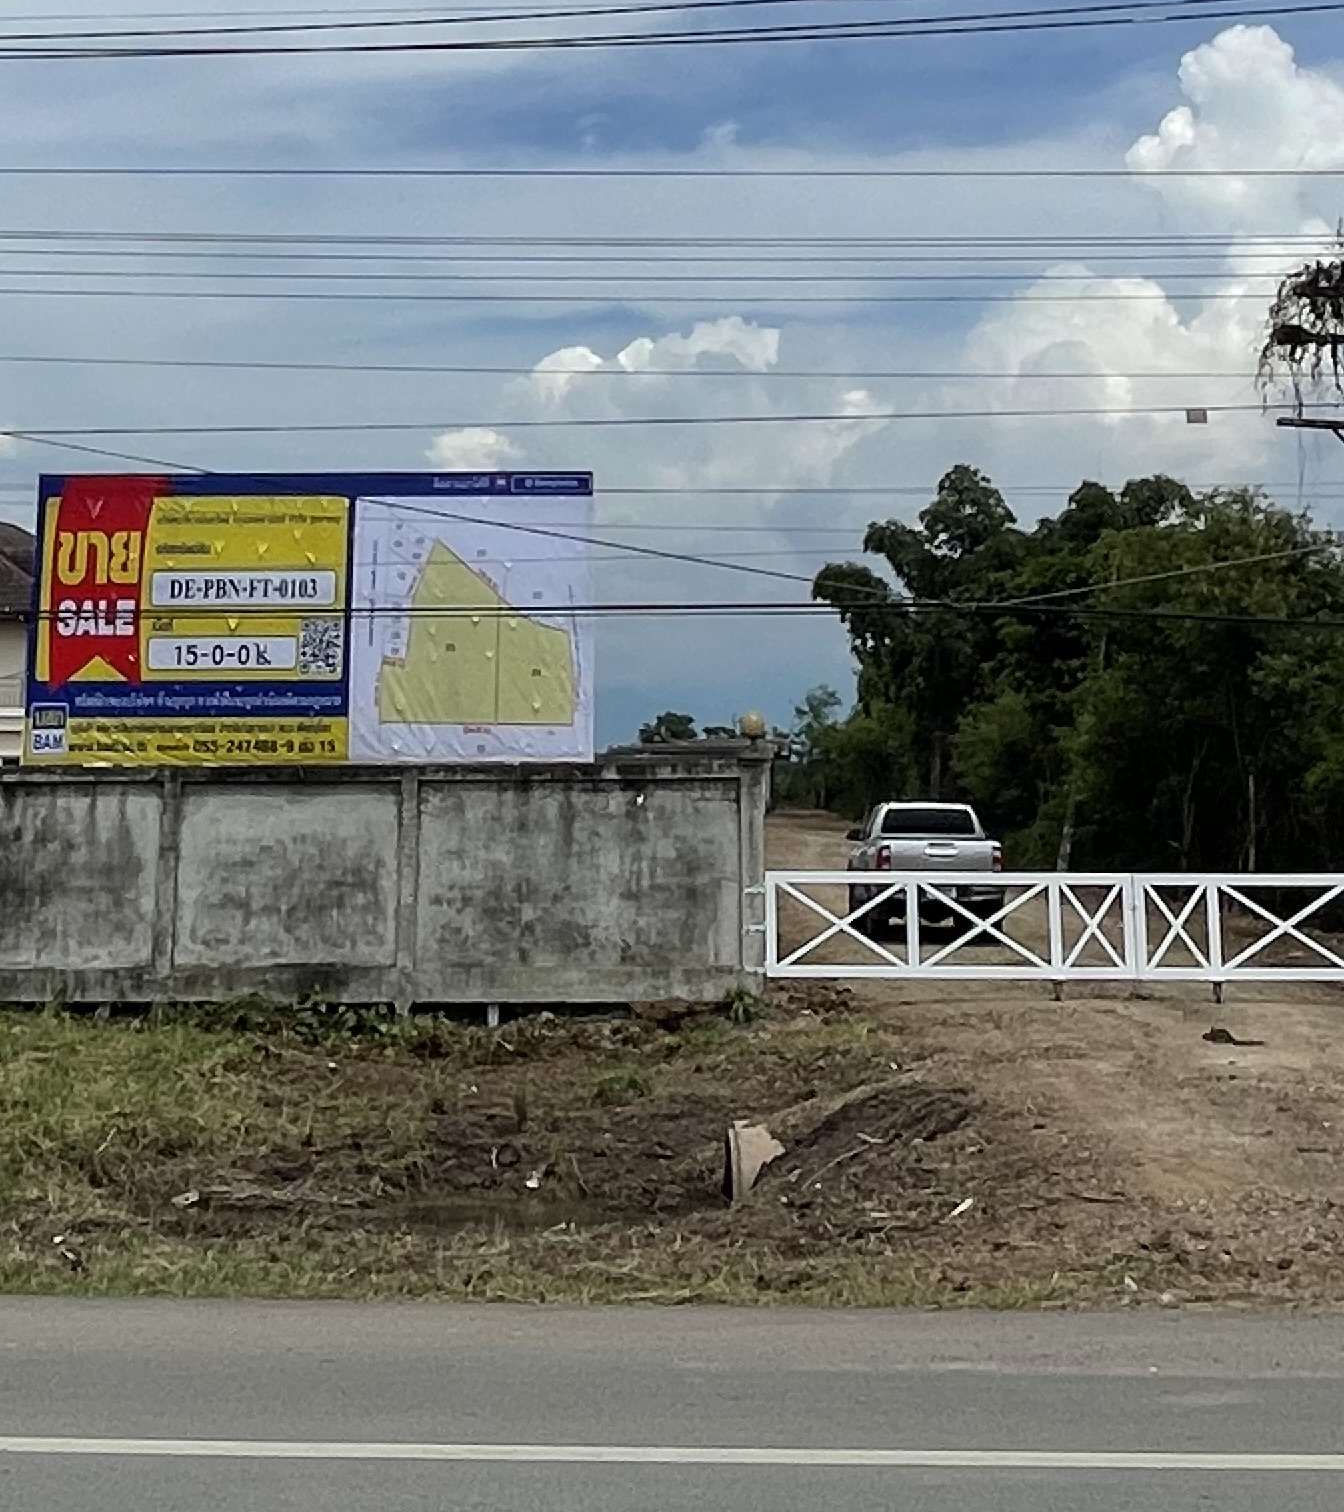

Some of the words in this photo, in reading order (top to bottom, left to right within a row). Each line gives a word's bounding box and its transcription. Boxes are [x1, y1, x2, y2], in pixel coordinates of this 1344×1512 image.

[58, 530, 142, 585] ขาย
[169, 577, 319, 600] DE-PBN-FT-0103
[57, 598, 136, 636] SALE
